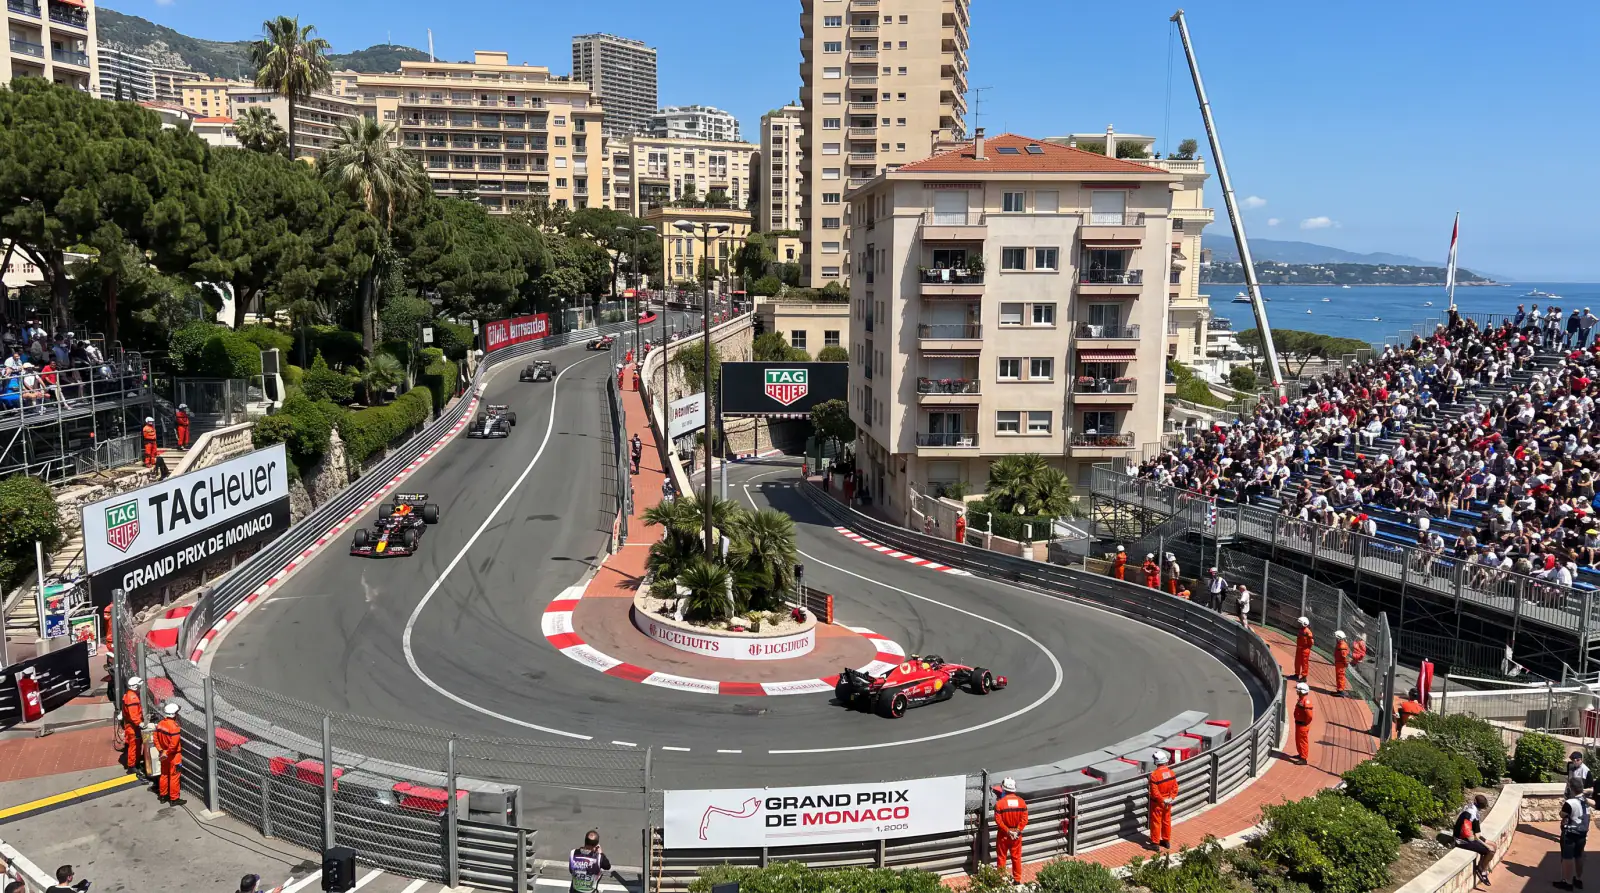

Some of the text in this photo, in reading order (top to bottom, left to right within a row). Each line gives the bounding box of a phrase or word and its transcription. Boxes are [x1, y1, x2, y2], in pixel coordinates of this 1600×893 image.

[768, 371, 804, 382] TAG
[767, 385, 805, 402] HEUER
[108, 504, 136, 525] TAG
[109, 522, 138, 548] HEUER
[122, 512, 273, 593] GRAND PRIX DE MONACO
[765, 789, 909, 811] GRAND PRIX
[765, 806, 910, 828] DE MONACO
